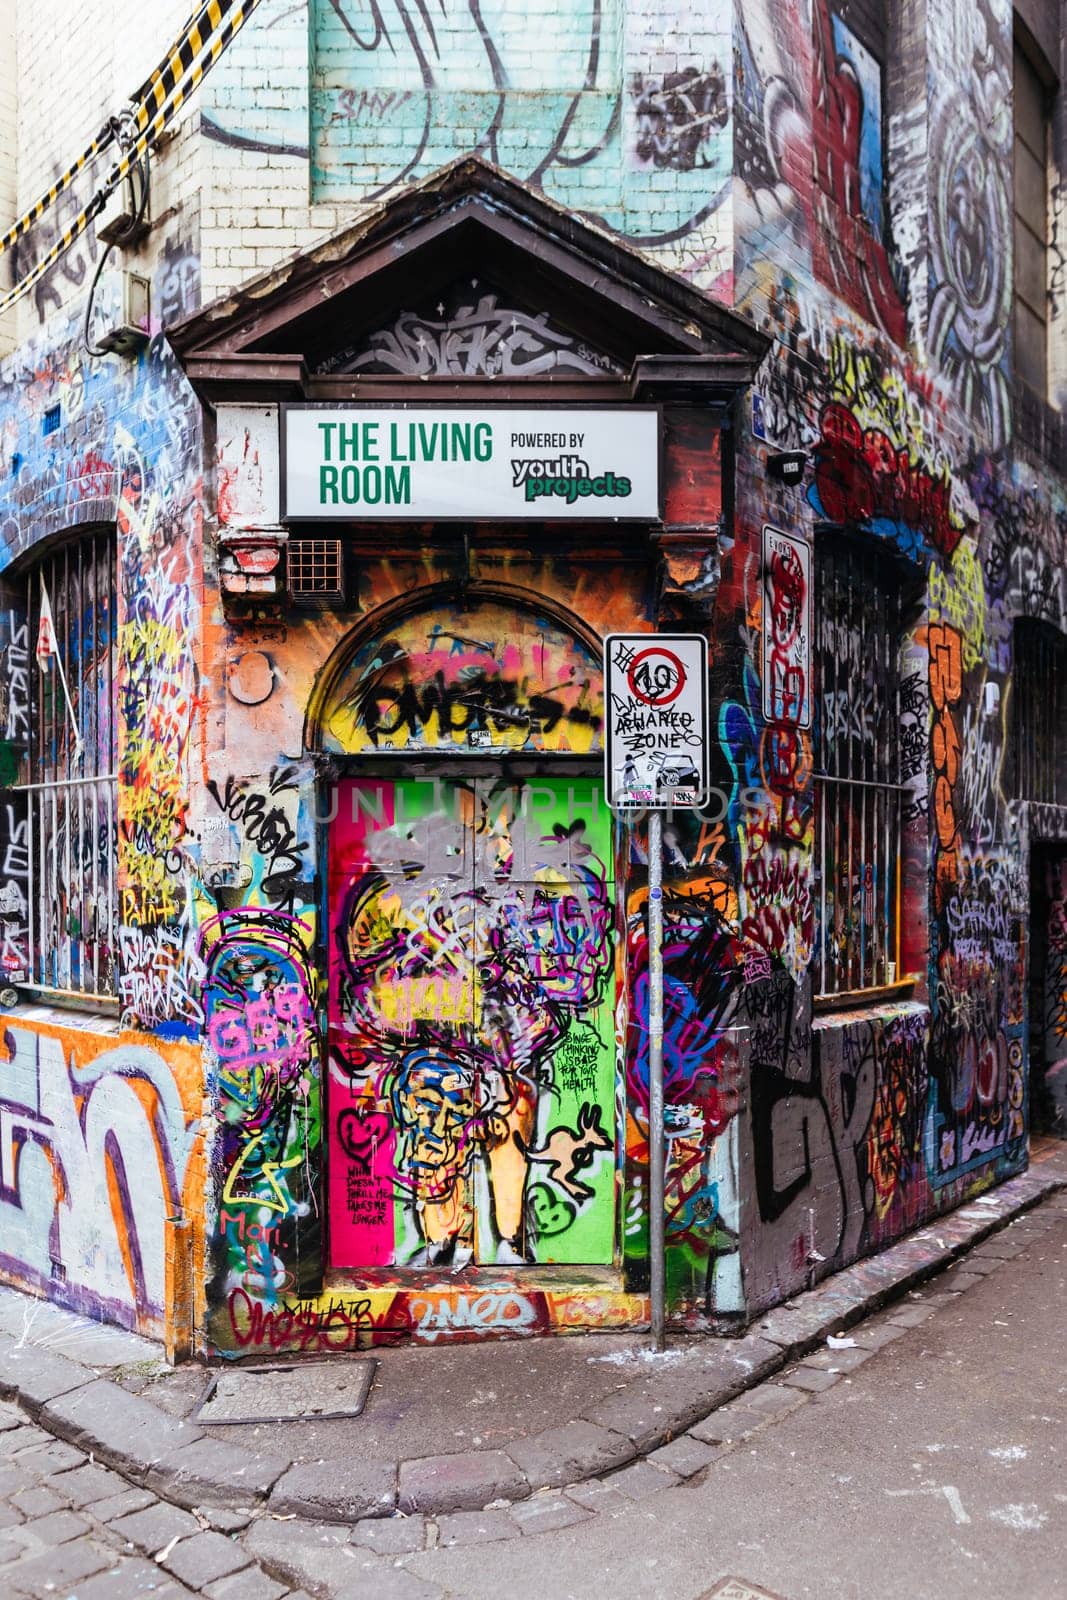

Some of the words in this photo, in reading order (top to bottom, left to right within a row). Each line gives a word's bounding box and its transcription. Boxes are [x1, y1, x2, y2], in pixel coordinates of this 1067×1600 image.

[318, 422, 379, 461] THE
[391, 422, 493, 462] LIVING
[511, 433, 566, 448] POWERED
[569, 433, 584, 448] BY
[319, 465, 411, 504] ROOM
[511, 455, 589, 488] youth
[525, 472, 631, 504] projects
[622, 712, 692, 727] SHARED
[632, 733, 681, 748] ZONE
